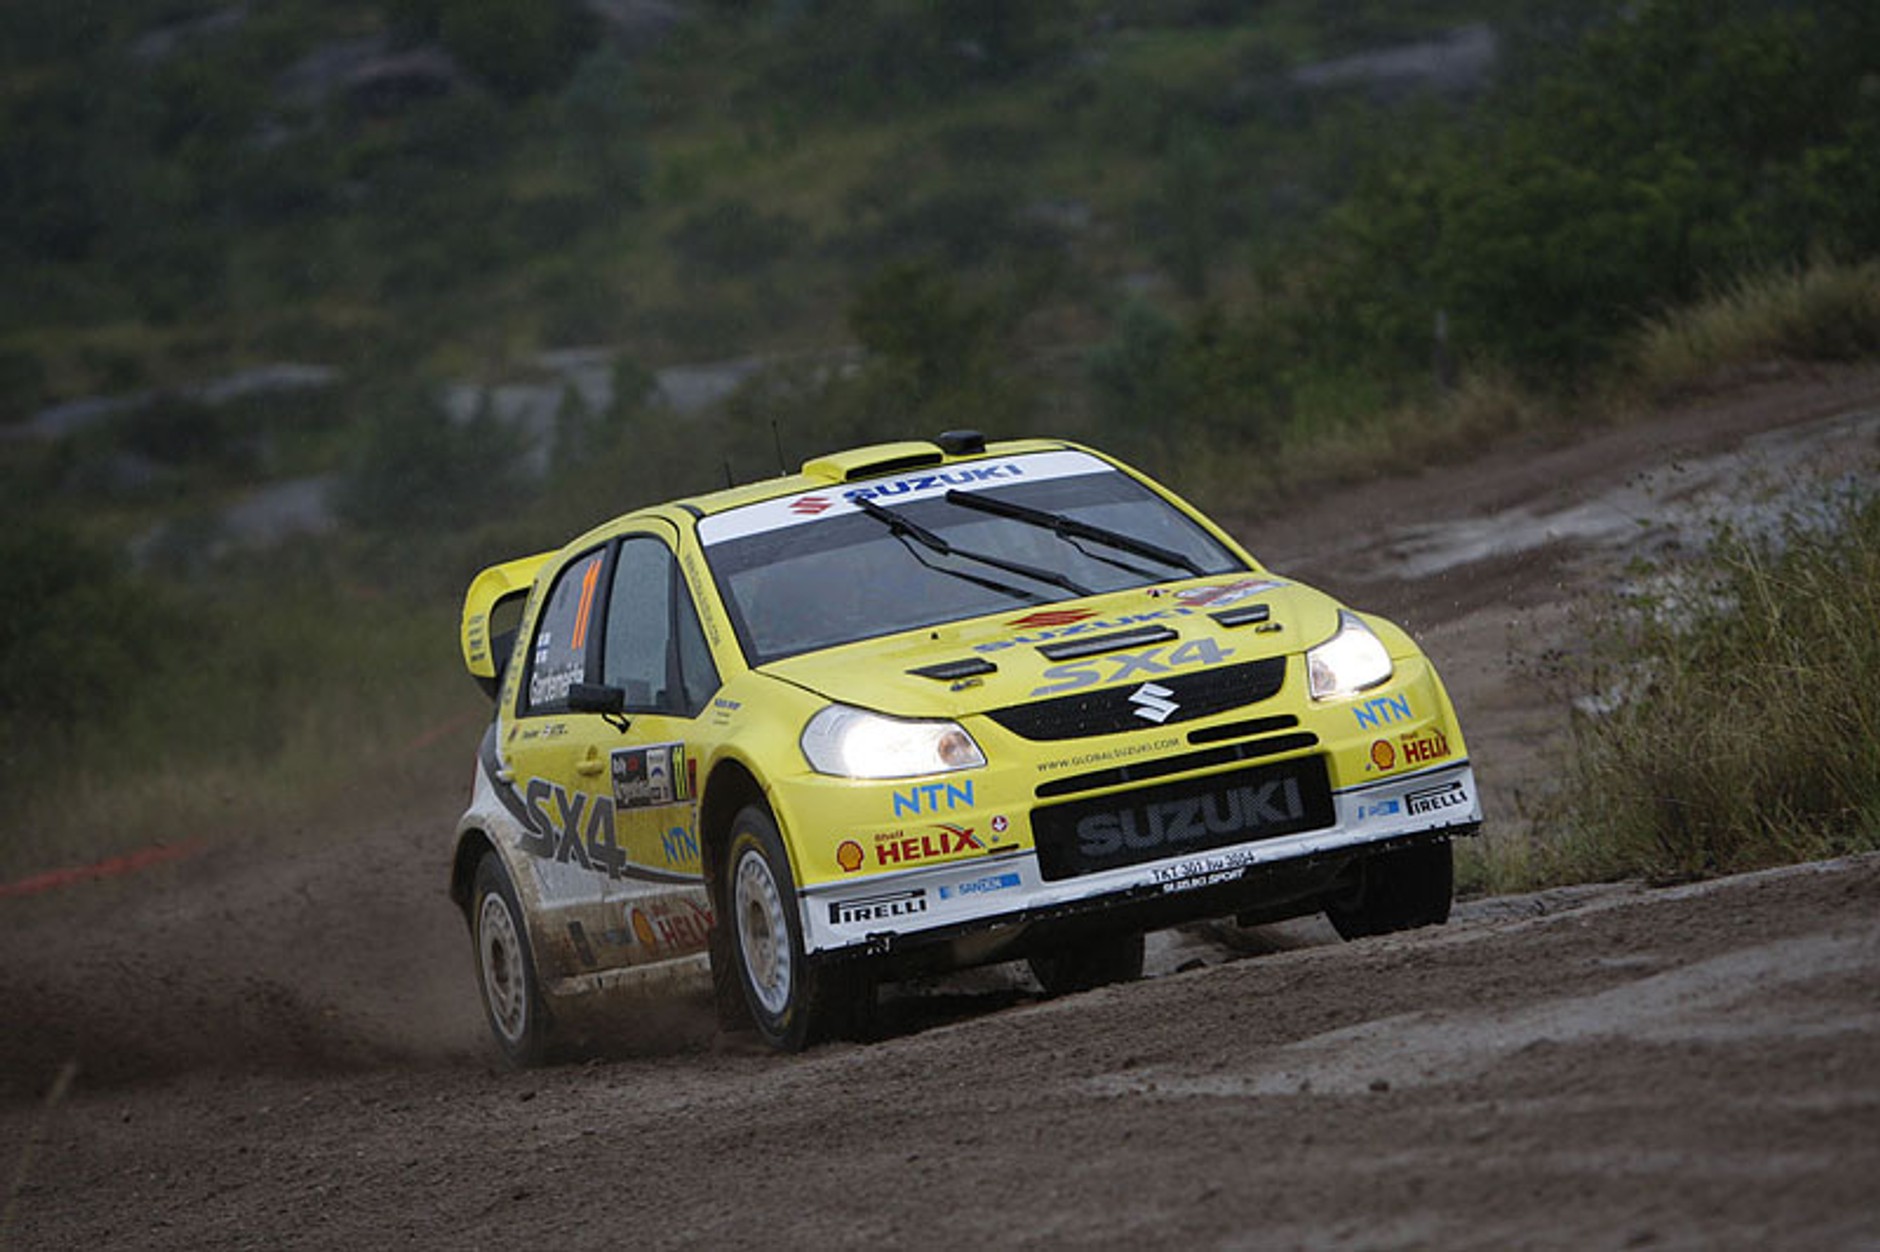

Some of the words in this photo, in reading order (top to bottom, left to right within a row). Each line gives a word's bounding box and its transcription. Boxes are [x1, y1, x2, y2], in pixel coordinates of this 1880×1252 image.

[842, 463, 1024, 502] SUZUKI
[571, 558, 603, 651] 11
[972, 607, 1195, 652] SUZUKI
[1030, 636, 1235, 697] SX4
[1351, 694, 1412, 730] NTN
[1402, 727, 1451, 764] HELIX
[893, 780, 974, 817] NTN
[1076, 777, 1304, 856] SUZUKI
[1404, 781, 1468, 815] PIRELLI
[515, 777, 628, 881] SX4
[660, 824, 700, 862] NTN
[875, 824, 987, 866] HELIX
[828, 889, 927, 925] PIRELLI
